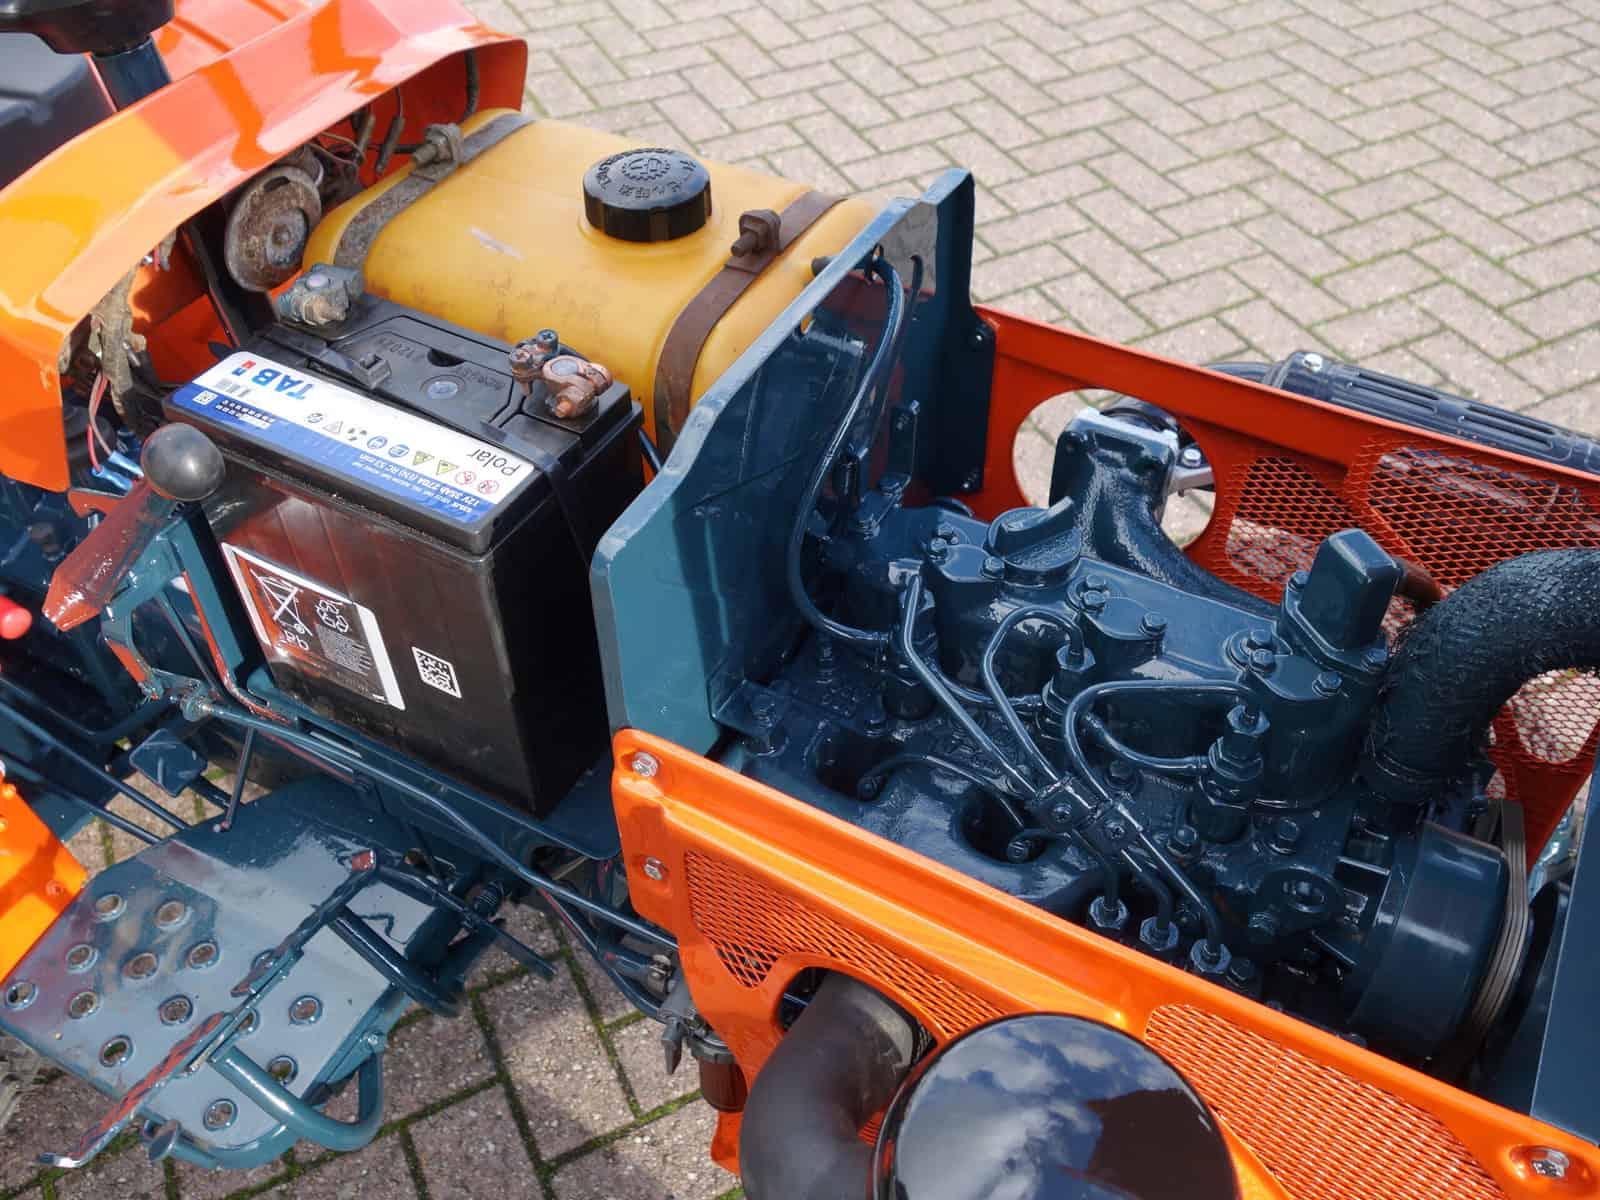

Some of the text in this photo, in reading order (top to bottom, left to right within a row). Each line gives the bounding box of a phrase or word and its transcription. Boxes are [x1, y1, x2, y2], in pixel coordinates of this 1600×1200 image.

[253, 367, 316, 400] TAB
[466, 446, 522, 477] Polar
[284, 630, 309, 650] Pb
